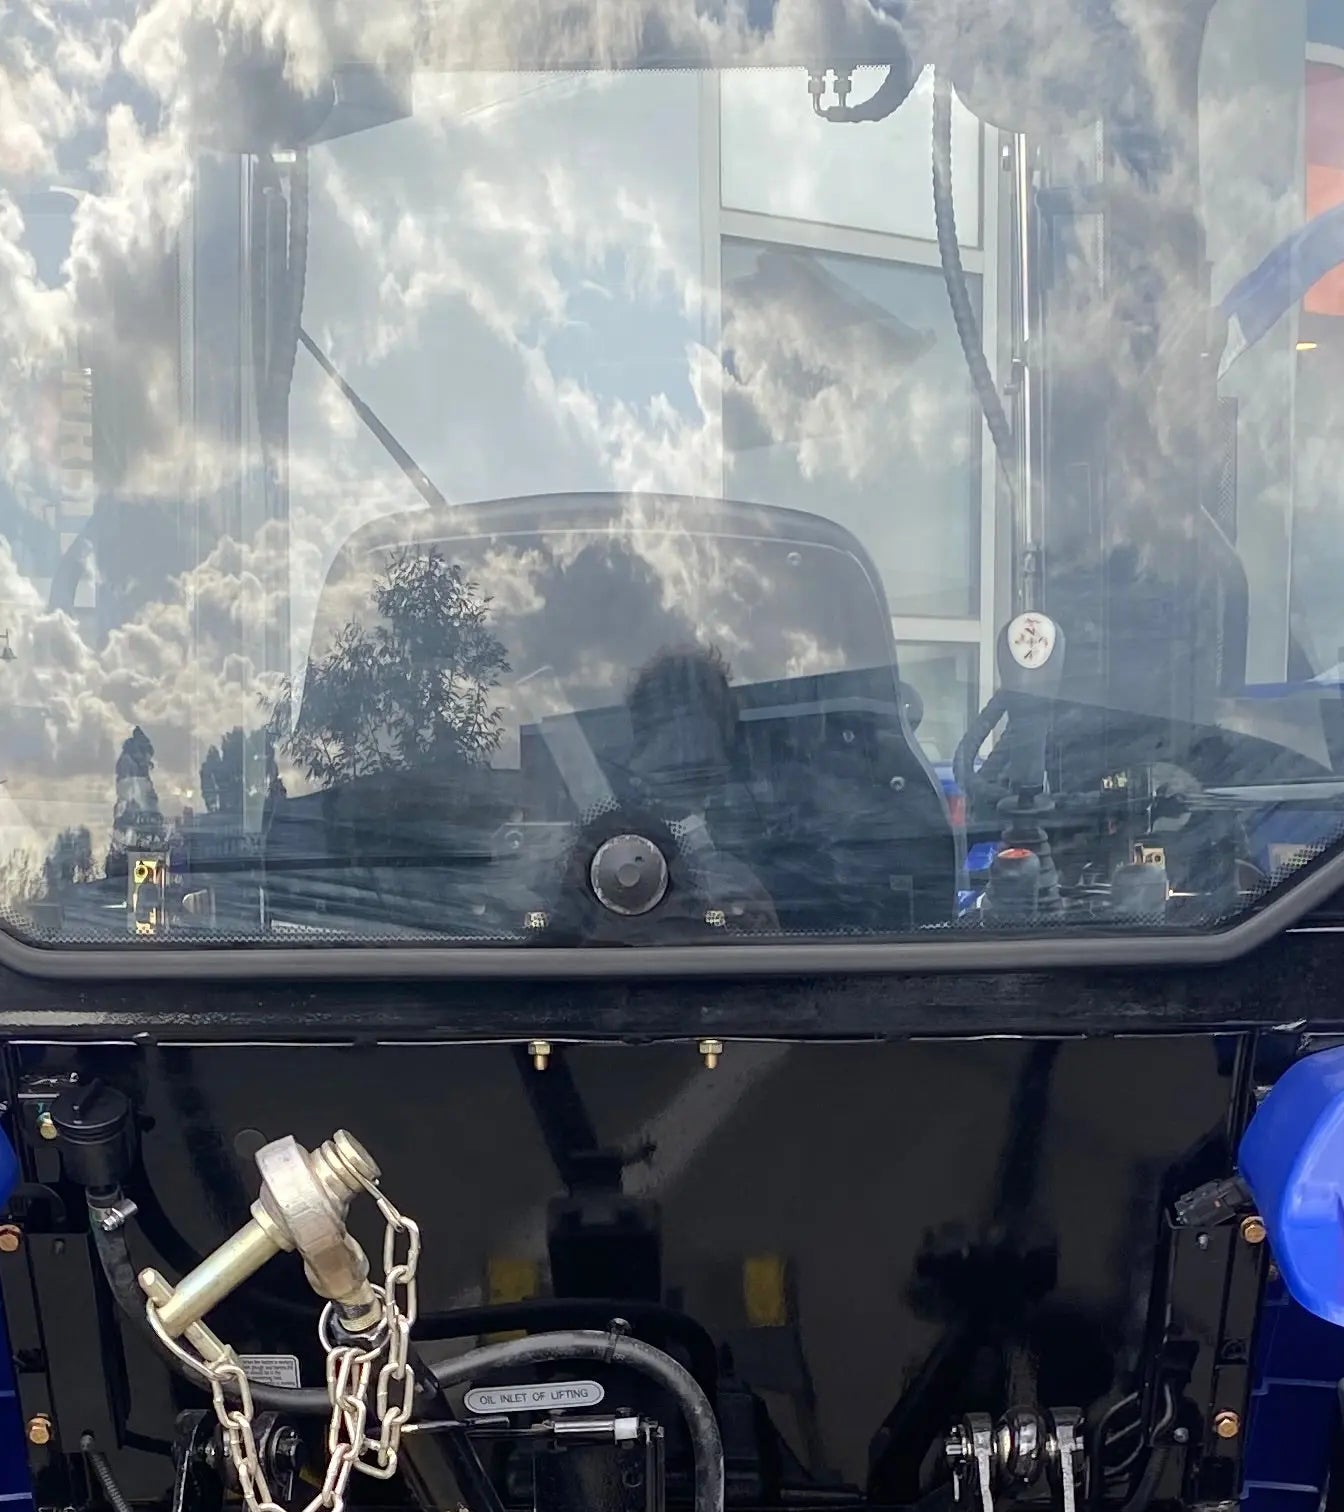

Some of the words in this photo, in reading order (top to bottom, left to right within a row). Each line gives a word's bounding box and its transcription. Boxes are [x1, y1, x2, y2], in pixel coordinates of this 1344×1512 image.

[479, 1395, 497, 1405] OIL
[500, 1392, 528, 1404] INLET
[551, 1388, 589, 1400] LIFTING
